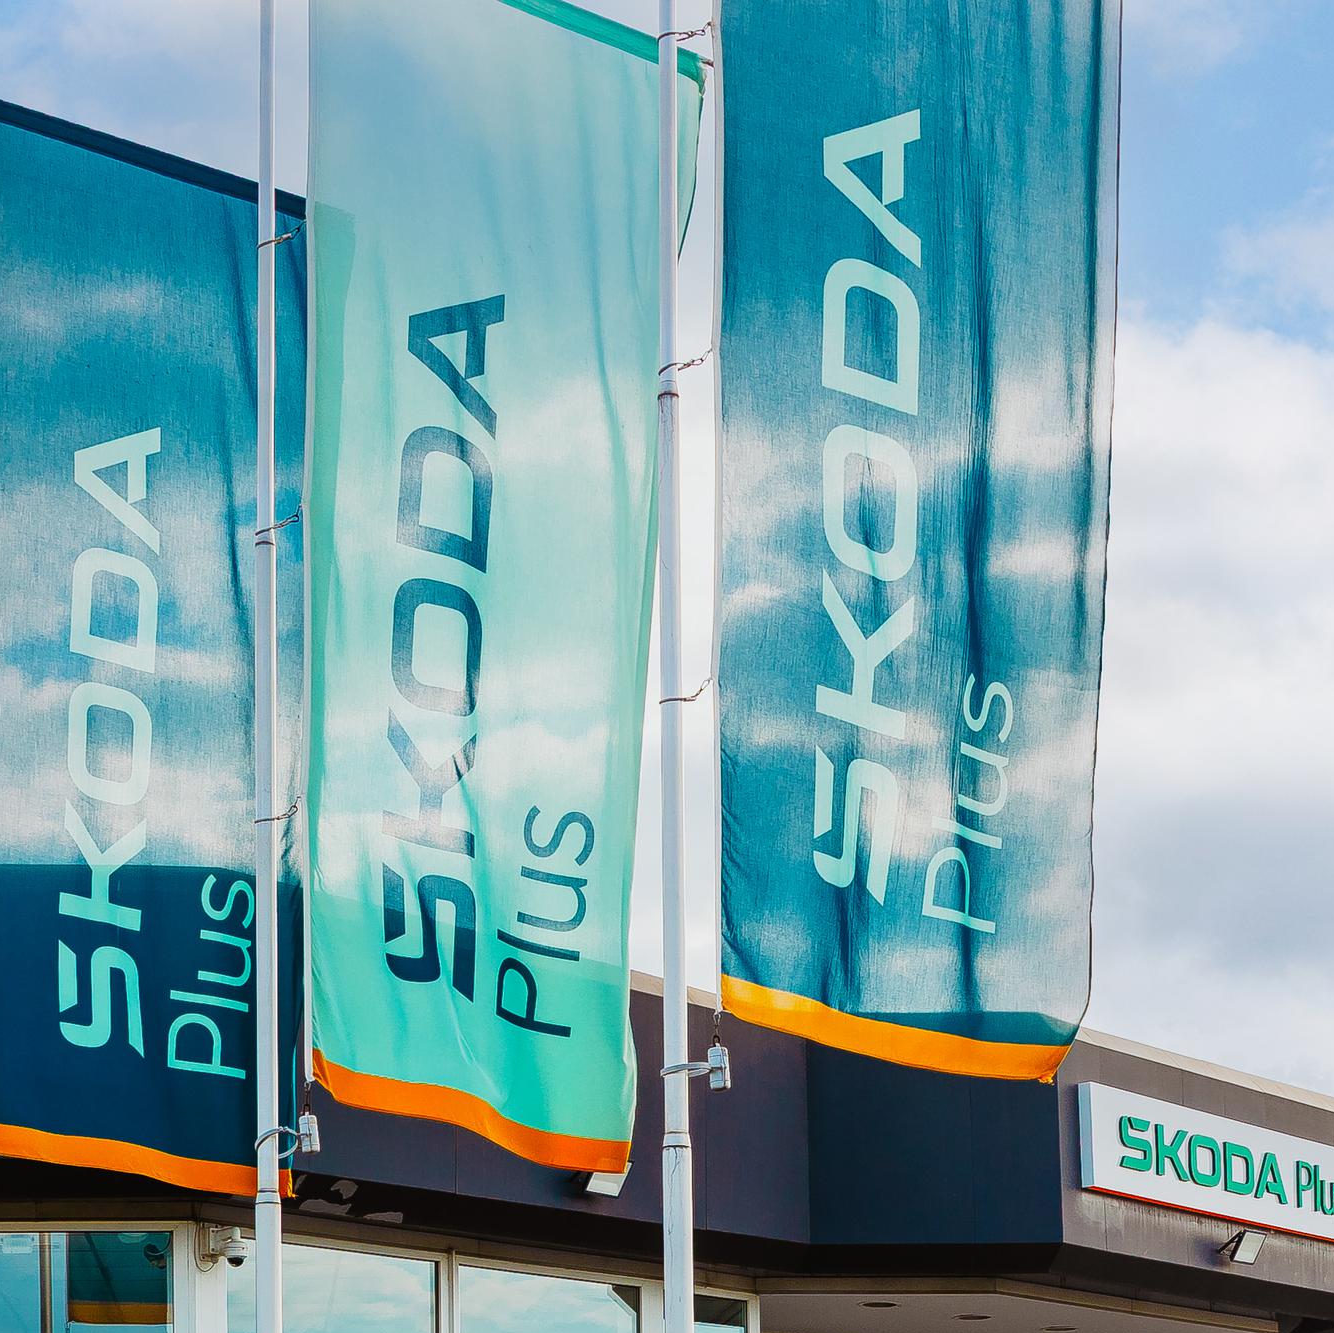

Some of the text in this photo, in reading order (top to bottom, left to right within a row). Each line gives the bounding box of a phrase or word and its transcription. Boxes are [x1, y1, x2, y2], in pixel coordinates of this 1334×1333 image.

[921, 673, 1015, 934] Plus
[167, 873, 255, 1079] Plus
[495, 804, 595, 1038] Plus
